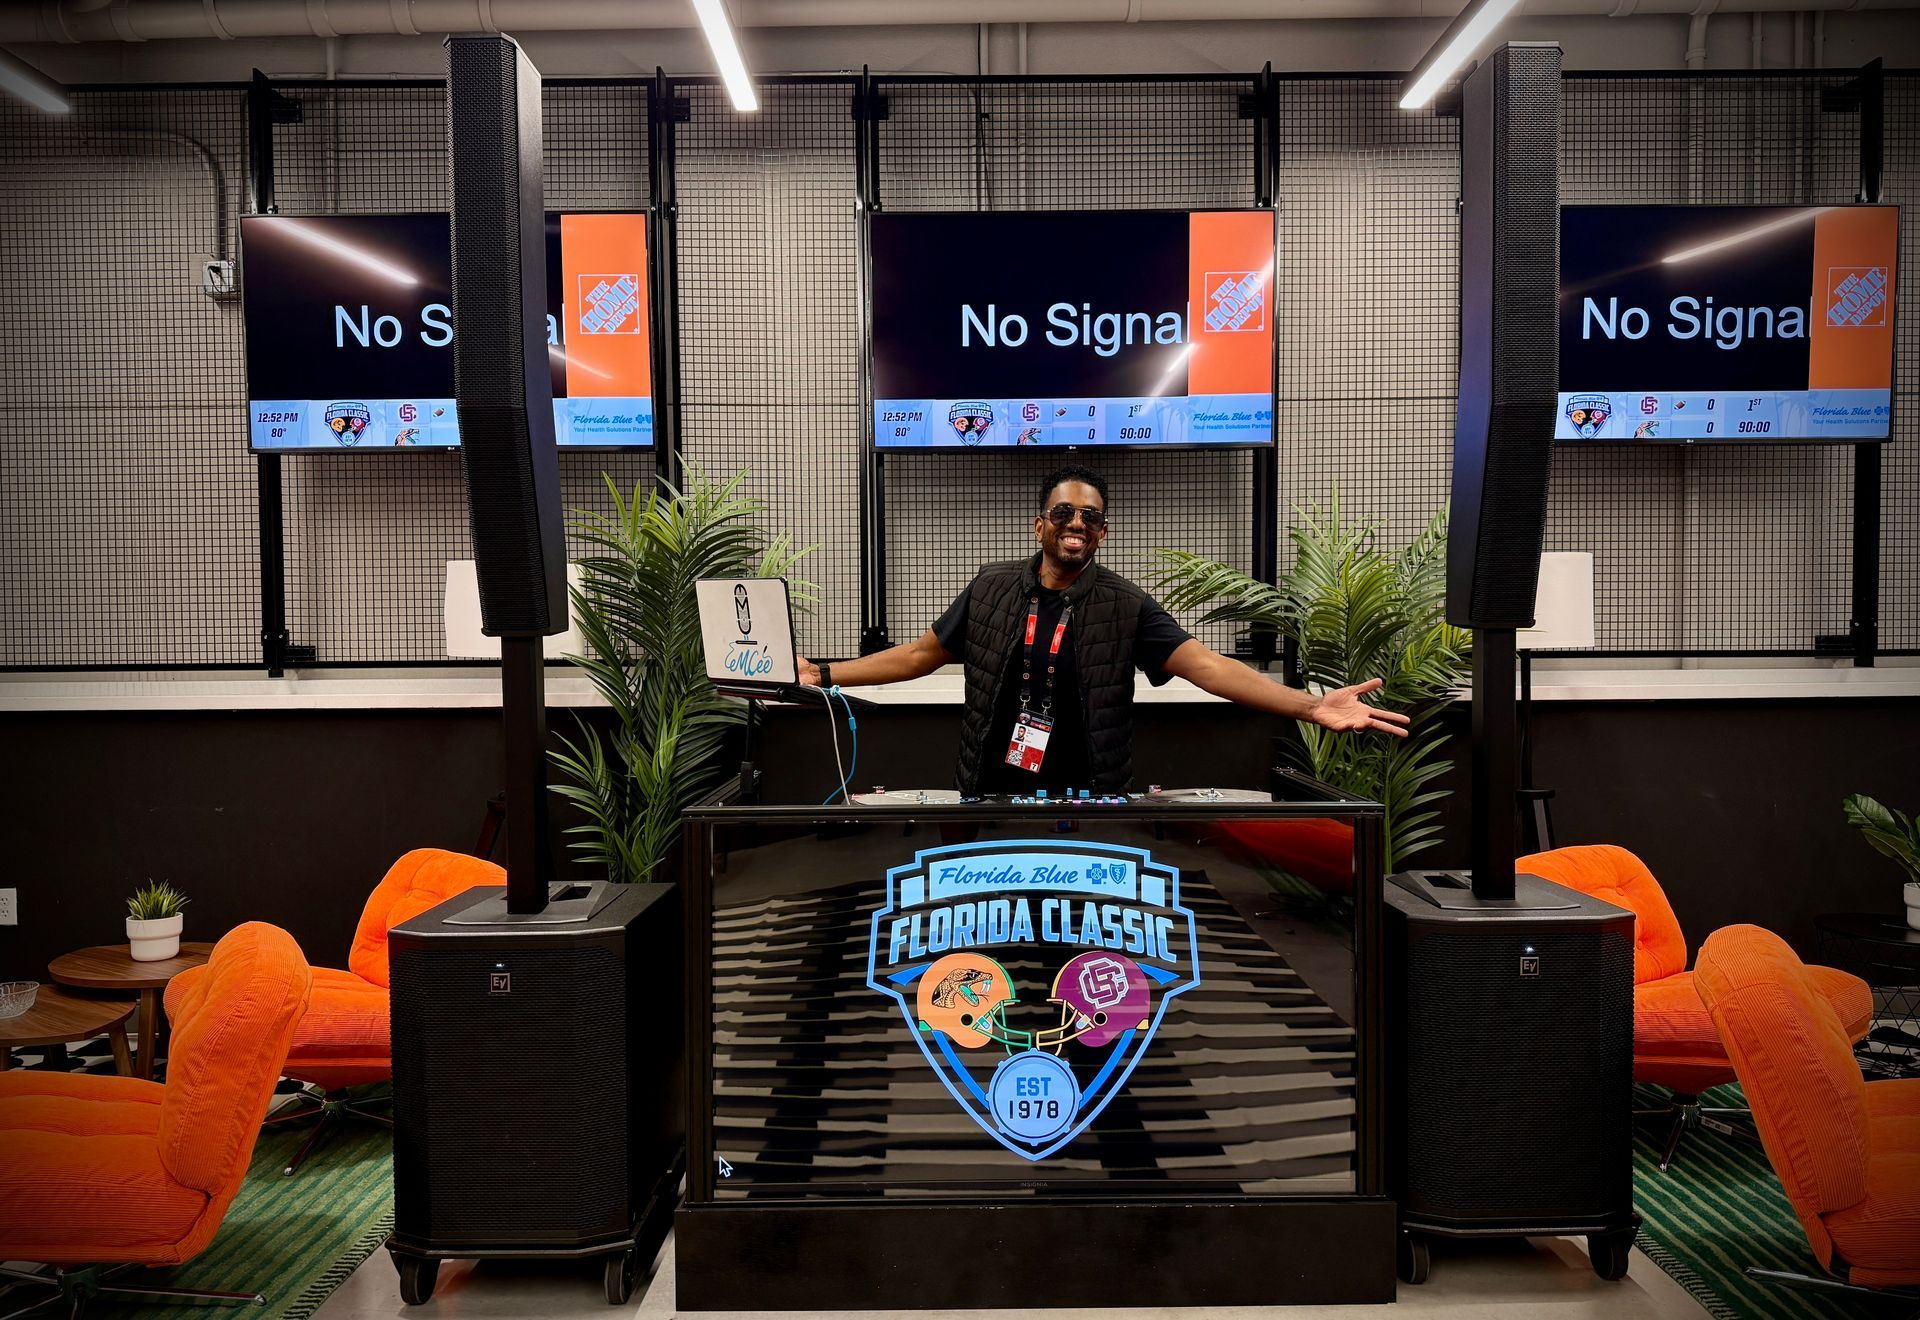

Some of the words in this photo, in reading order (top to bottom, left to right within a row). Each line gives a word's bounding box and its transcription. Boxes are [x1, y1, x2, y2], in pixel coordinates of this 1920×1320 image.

[1828, 267, 1886, 325] HOME
[581, 274, 639, 334] HOME
[1582, 297, 1650, 340] No
[335, 304, 403, 348] No
[962, 304, 1029, 347] No
[1707, 398, 1715, 411] 0
[882, 412, 906, 422] 12:52
[908, 412, 923, 422] PM
[1088, 405, 1096, 417] 0
[1193, 412, 1230, 421] Florida
[1231, 411, 1252, 421] Blue
[1812, 406, 1849, 416] Florida
[1850, 406, 1872, 416] Blue
[257, 412, 282, 423] 12:52
[283, 412, 299, 422] PM
[573, 414, 610, 424] Florida
[611, 414, 633, 424] Blue
[271, 427, 287, 438] 80°
[895, 427, 911, 437] 80°
[1119, 427, 1151, 439] 90:00
[1706, 421, 1714, 433] 0
[1738, 421, 1771, 433] 90:00
[1088, 428, 1096, 440] 0
[938, 863, 1026, 886] Florida
[1029, 863, 1079, 885] Blue
[888, 898, 1035, 965] FLORIDA
[1041, 898, 1178, 964] CLASSIC
[1015, 1076, 1052, 1097] EST
[1009, 1099, 1060, 1120] 1978
